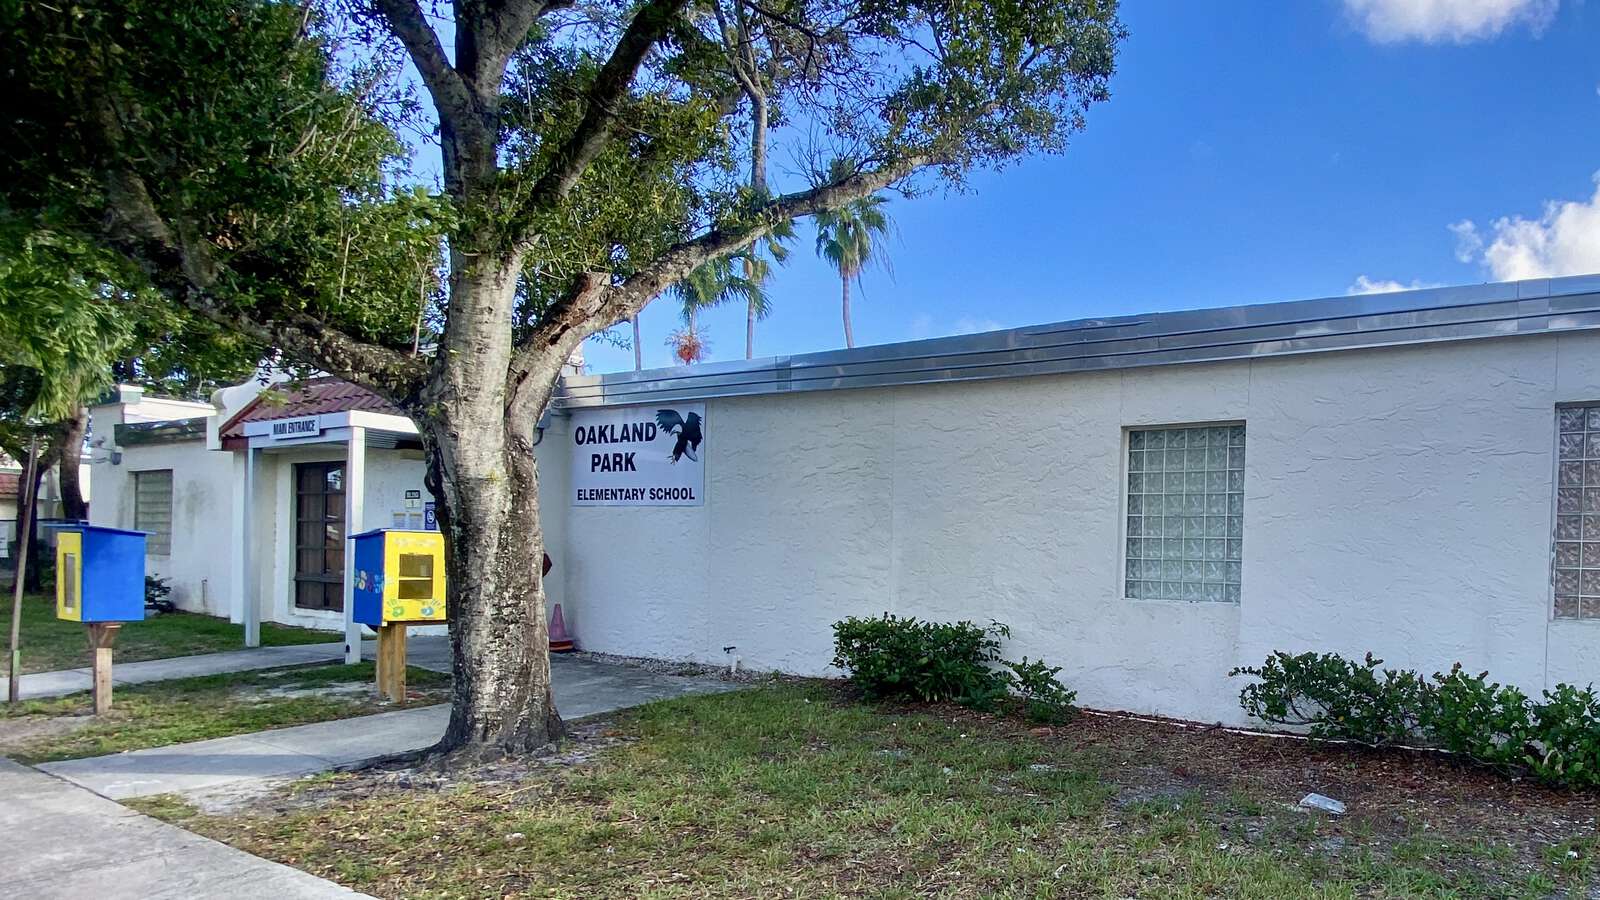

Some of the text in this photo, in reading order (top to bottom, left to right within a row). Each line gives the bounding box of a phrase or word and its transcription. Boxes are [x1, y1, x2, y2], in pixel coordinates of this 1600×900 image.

[273, 419, 316, 435] MAIN ENTRANCE
[574, 422, 657, 446] OAKLAND
[591, 452, 637, 473] PARK
[577, 487, 696, 501] ELEMENTARY SCHOOL
